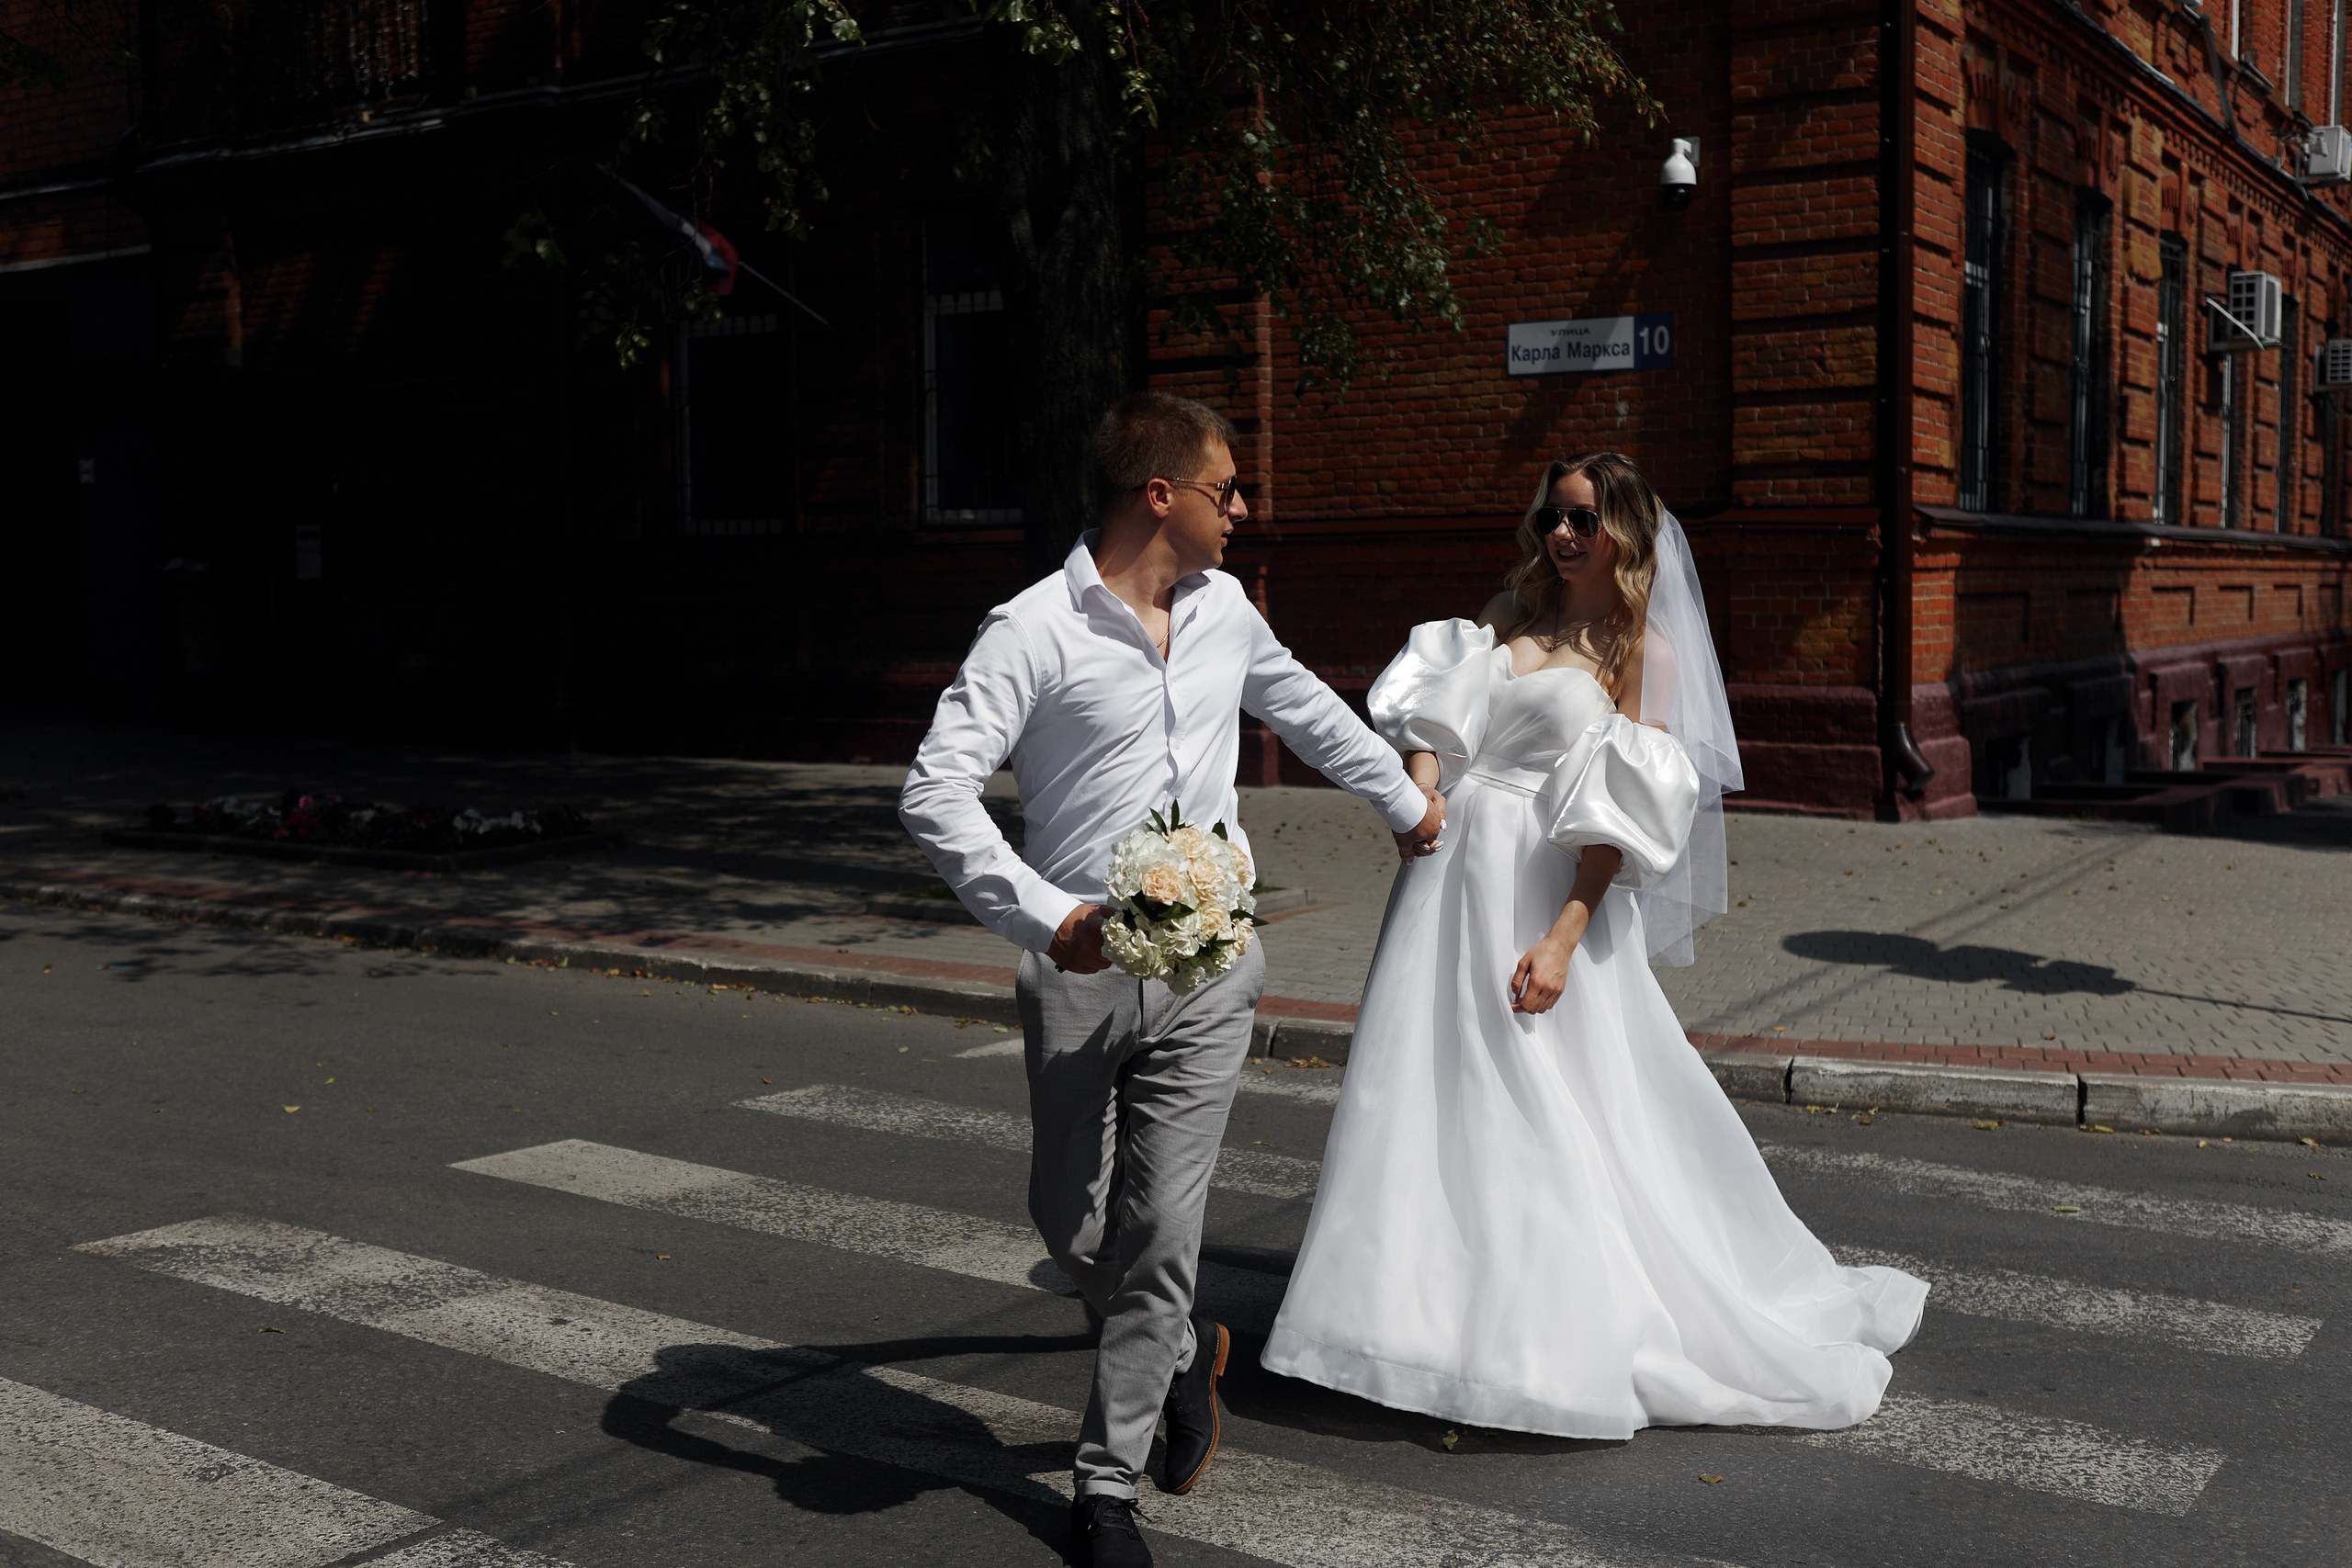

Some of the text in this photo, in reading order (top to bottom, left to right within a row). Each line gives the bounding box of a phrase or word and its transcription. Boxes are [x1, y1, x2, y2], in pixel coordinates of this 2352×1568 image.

[1511, 341, 1630, 365] Карла Маркса
[1639, 324, 1669, 355] 10
